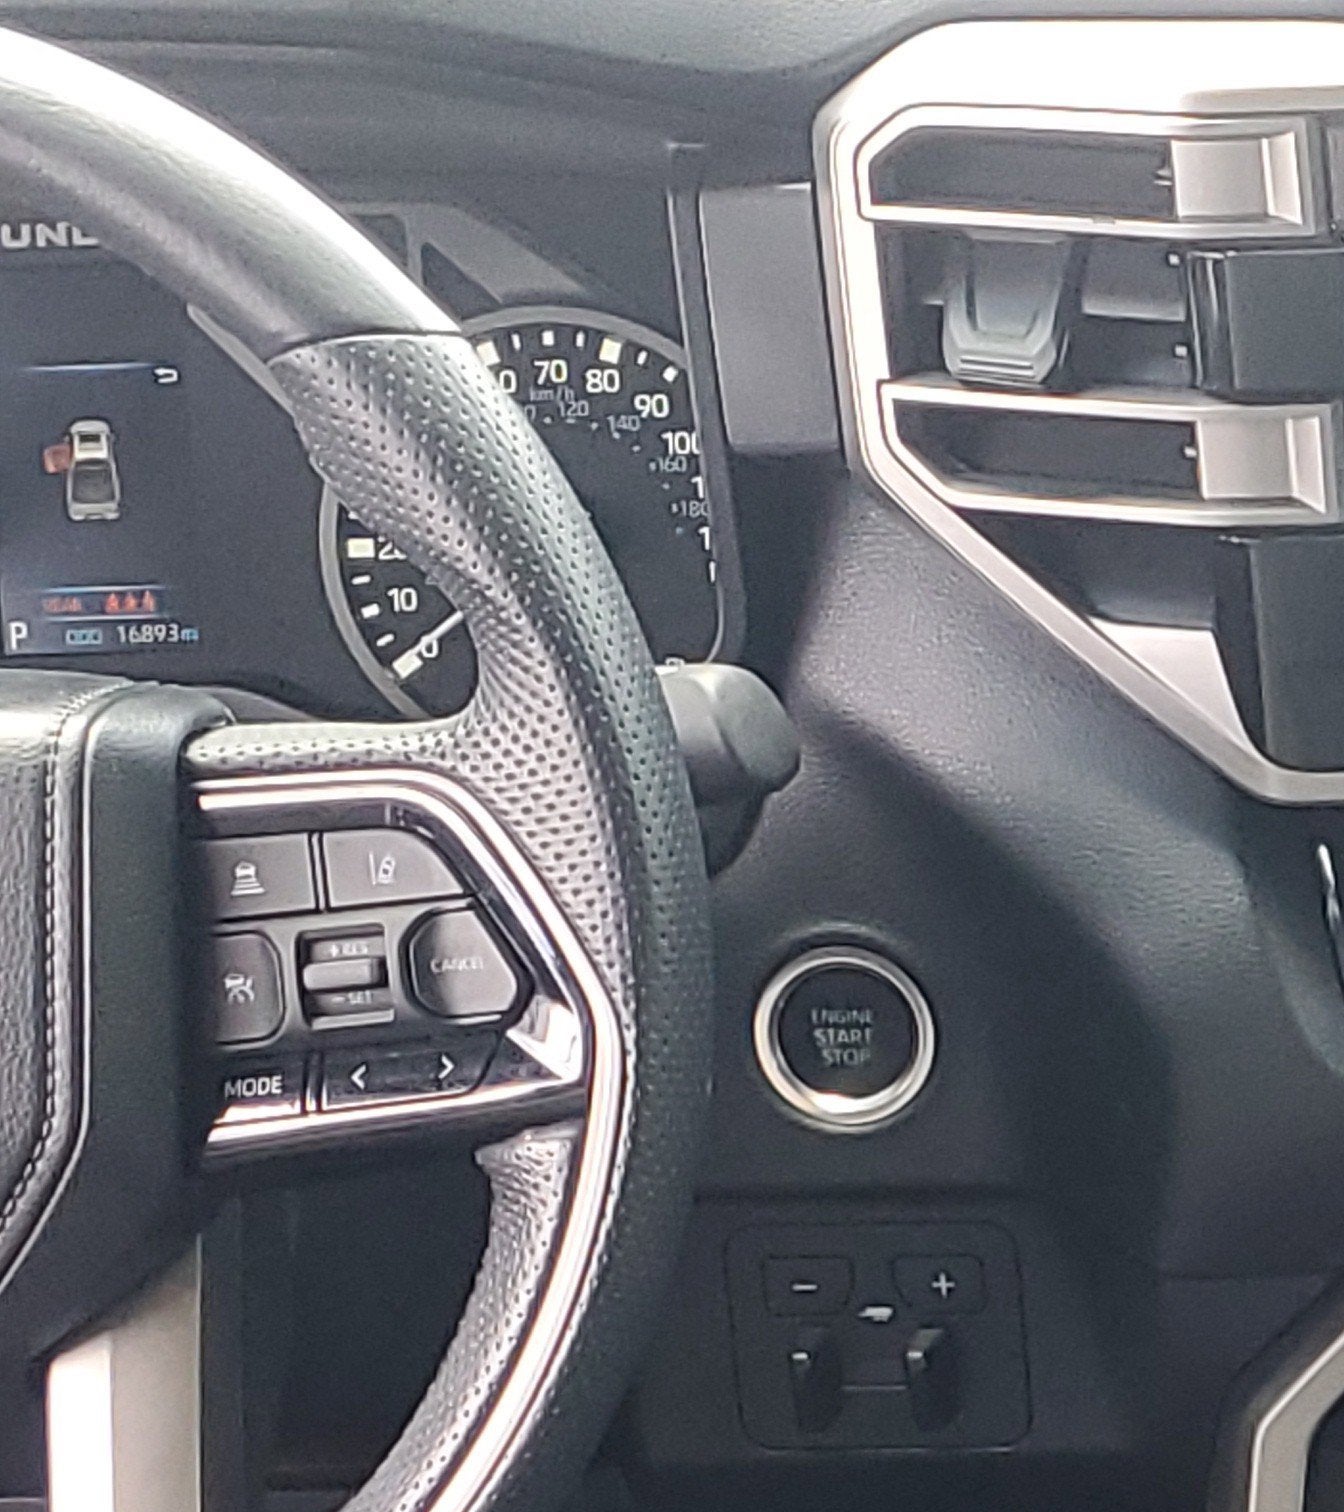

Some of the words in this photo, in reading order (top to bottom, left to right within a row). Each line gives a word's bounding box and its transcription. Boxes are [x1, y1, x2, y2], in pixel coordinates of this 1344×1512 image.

[533, 358, 568, 384] 70
[585, 367, 621, 394] 80
[528, 385, 576, 402] km/h
[557, 399, 590, 418] 120
[633, 393, 670, 420] 90
[606, 415, 641, 431] 140
[656, 455, 688, 474] 160
[386, 586, 418, 613] 10
[8, 621, 29, 651] P
[115, 623, 179, 645] 16893
[429, 956, 486, 975] CANCEL
[810, 1009, 873, 1025] ENGINE
[812, 1027, 871, 1048] START
[821, 1047, 871, 1066] STOP
[223, 1074, 284, 1100] MODE
